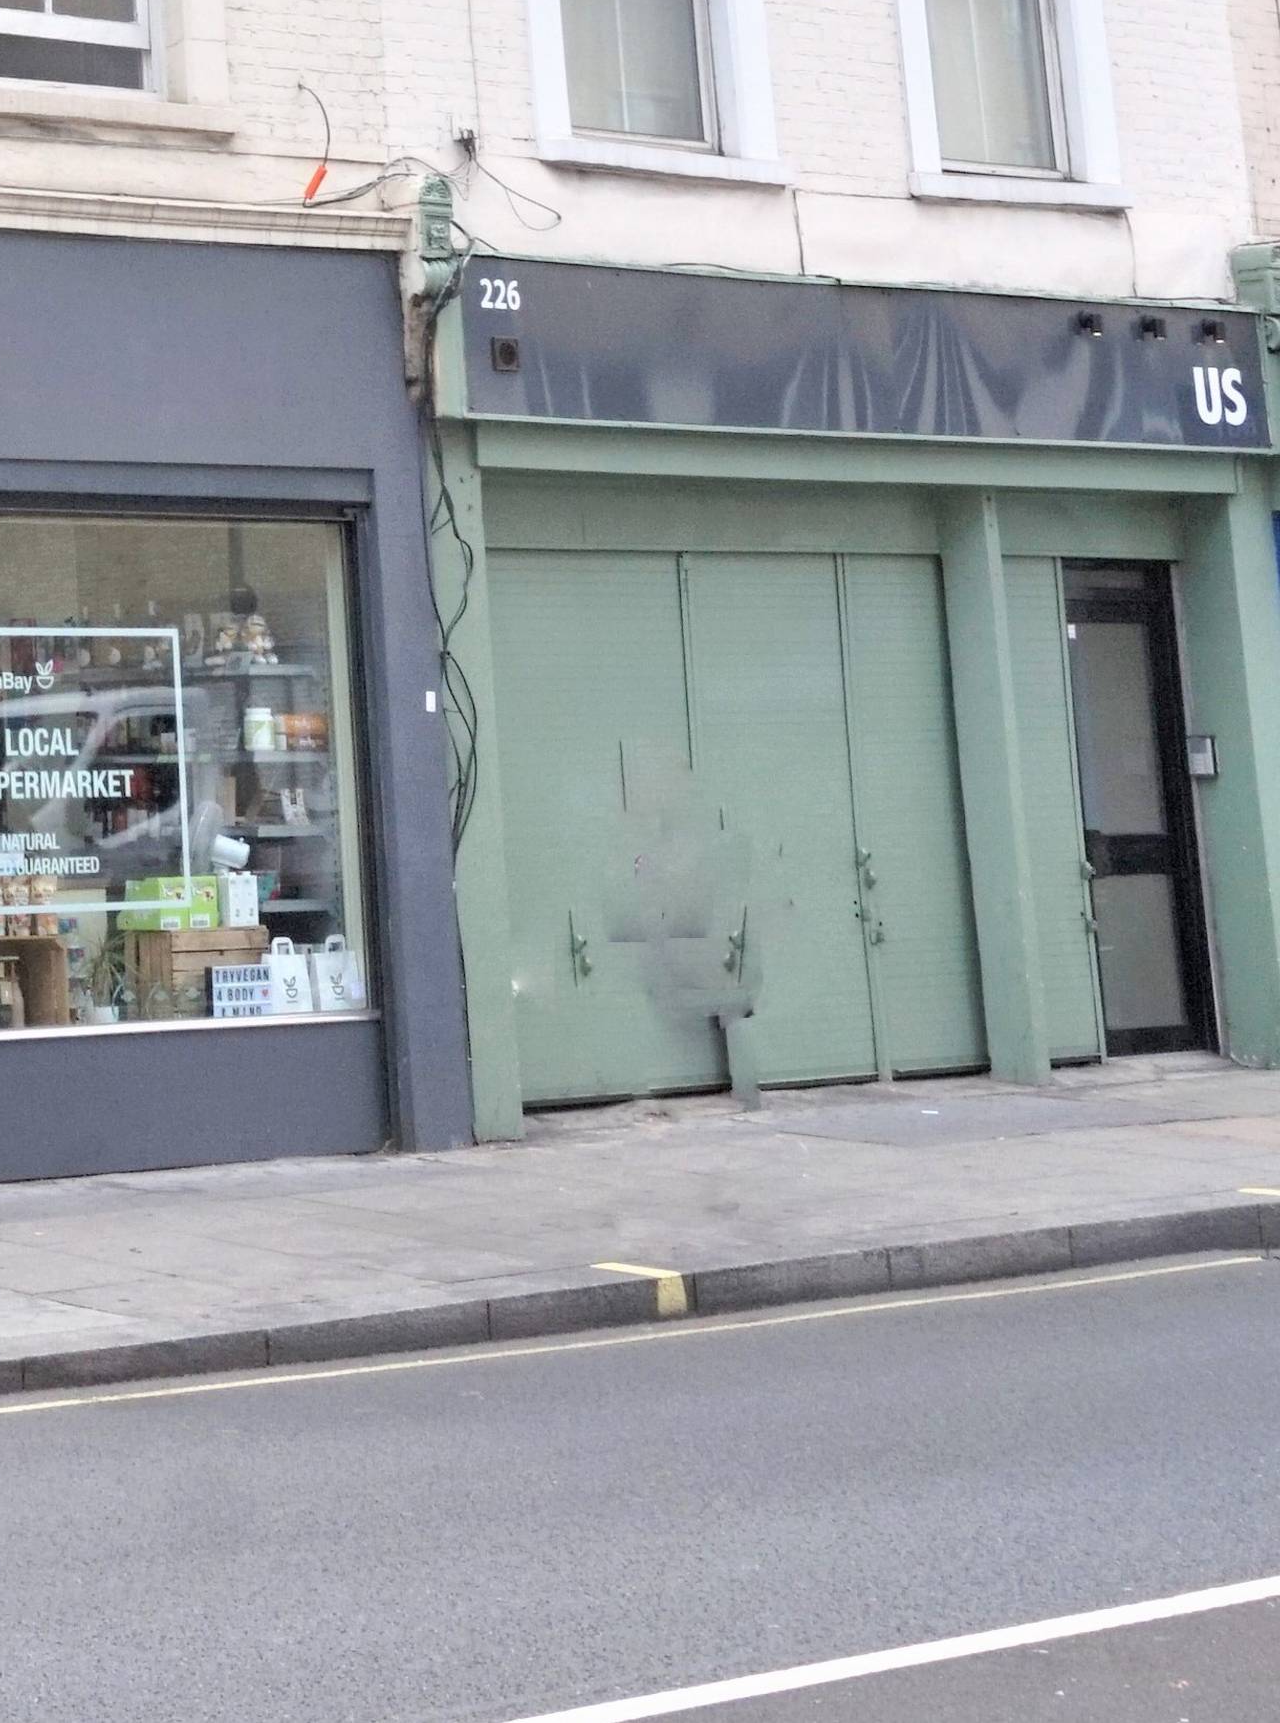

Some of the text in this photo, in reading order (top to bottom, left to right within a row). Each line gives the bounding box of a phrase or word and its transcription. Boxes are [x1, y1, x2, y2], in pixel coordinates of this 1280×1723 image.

[480, 278, 521, 310] 226
[1193, 366, 1247, 427] US
[5, 728, 80, 757] LOCAL
[2, 832, 61, 852] NATURAL
[16, 856, 100, 876] GUARANTEED
[227, 988, 255, 1002] BODY
